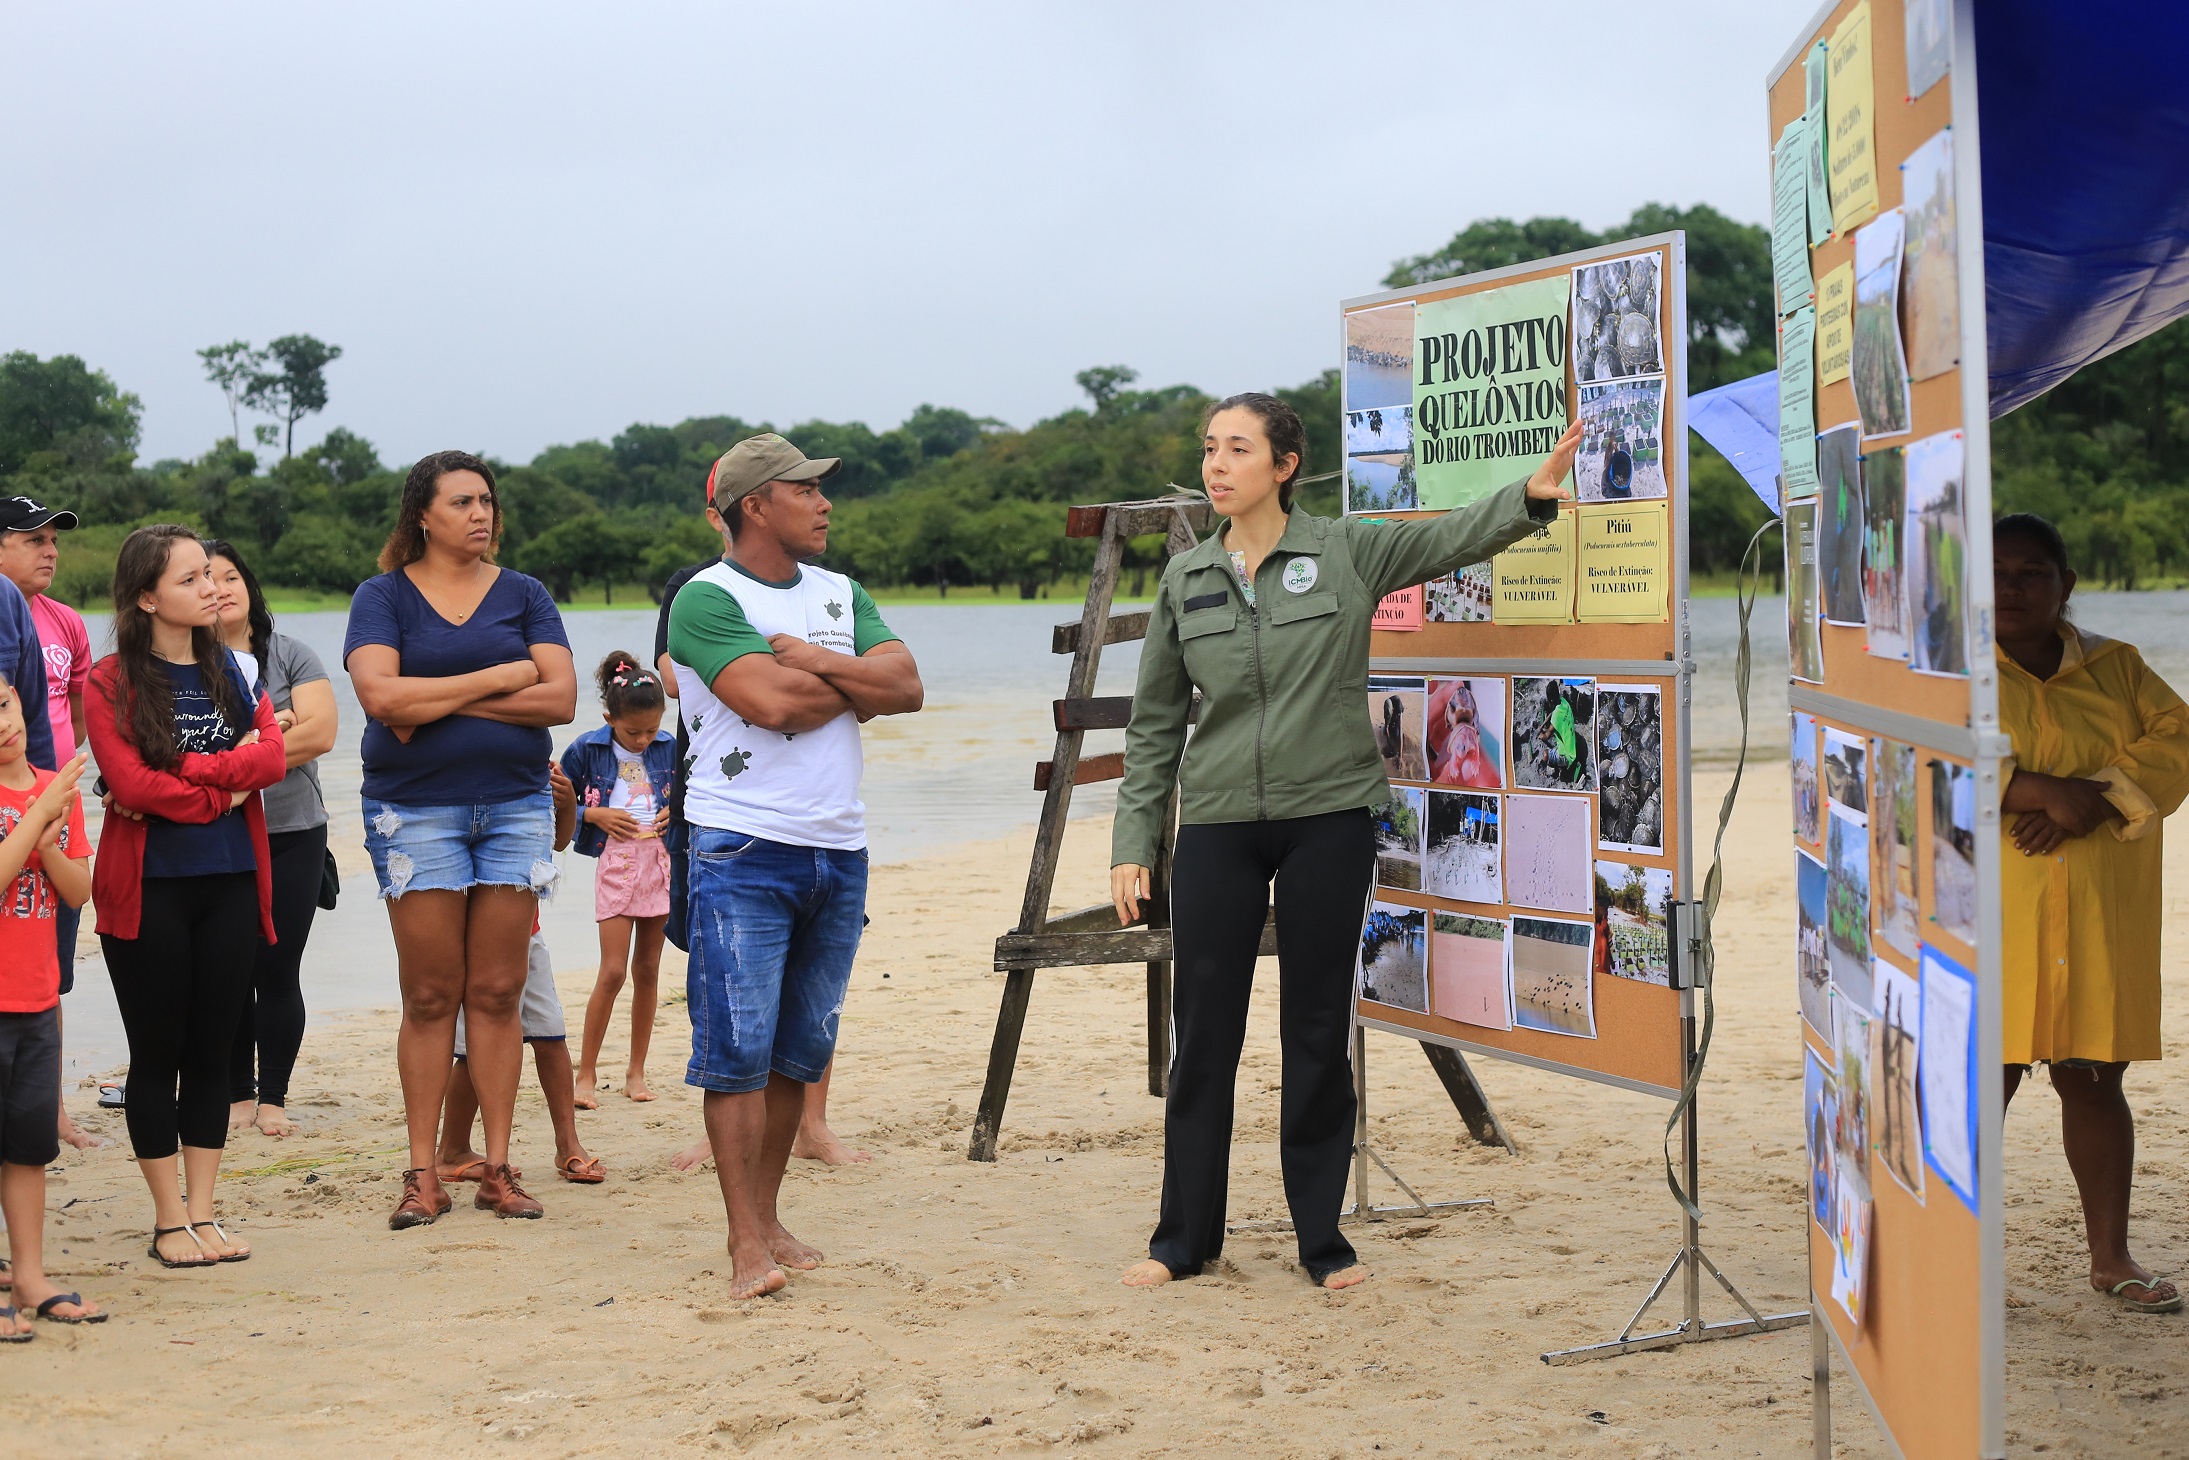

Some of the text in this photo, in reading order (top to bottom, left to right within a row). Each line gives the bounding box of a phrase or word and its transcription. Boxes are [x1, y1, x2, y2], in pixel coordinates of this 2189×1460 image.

[1418, 314, 1565, 386] PROJETO
[1418, 375, 1566, 440] QUELÔNIOS
[1421, 438, 1444, 465] DO
[1446, 435, 1470, 462] RIO
[1606, 518, 1632, 535] Pitiú
[1588, 565, 1653, 578] Risco de Extinção:
[1288, 576, 1313, 586] ICMBio
[1501, 575, 1562, 587] Risco de Extinção:
[1591, 579, 1650, 593] VULNERÁVEL
[1400, 593, 1412, 604] DE
[1503, 588, 1558, 601] VULNERÁVEL
[808, 629, 829, 638] rojeto
[210, 718, 235, 742] Lov
